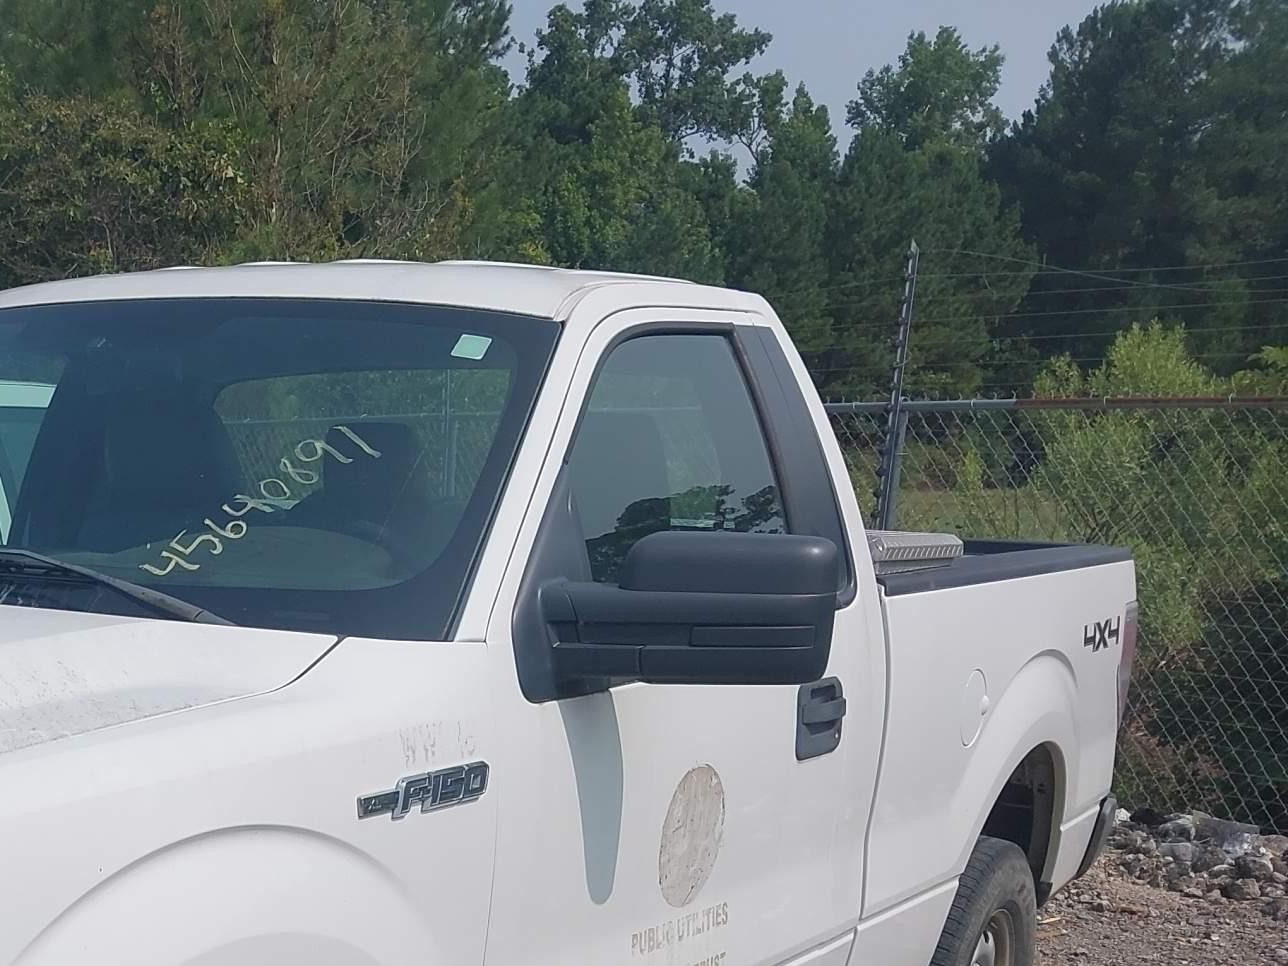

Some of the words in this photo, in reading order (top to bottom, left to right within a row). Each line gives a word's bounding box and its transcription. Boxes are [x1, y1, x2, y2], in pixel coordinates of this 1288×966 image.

[139, 426, 381, 575] 45640891
[631, 920, 674, 956] PUBLIC
[676, 901, 729, 942] UTILITIES
